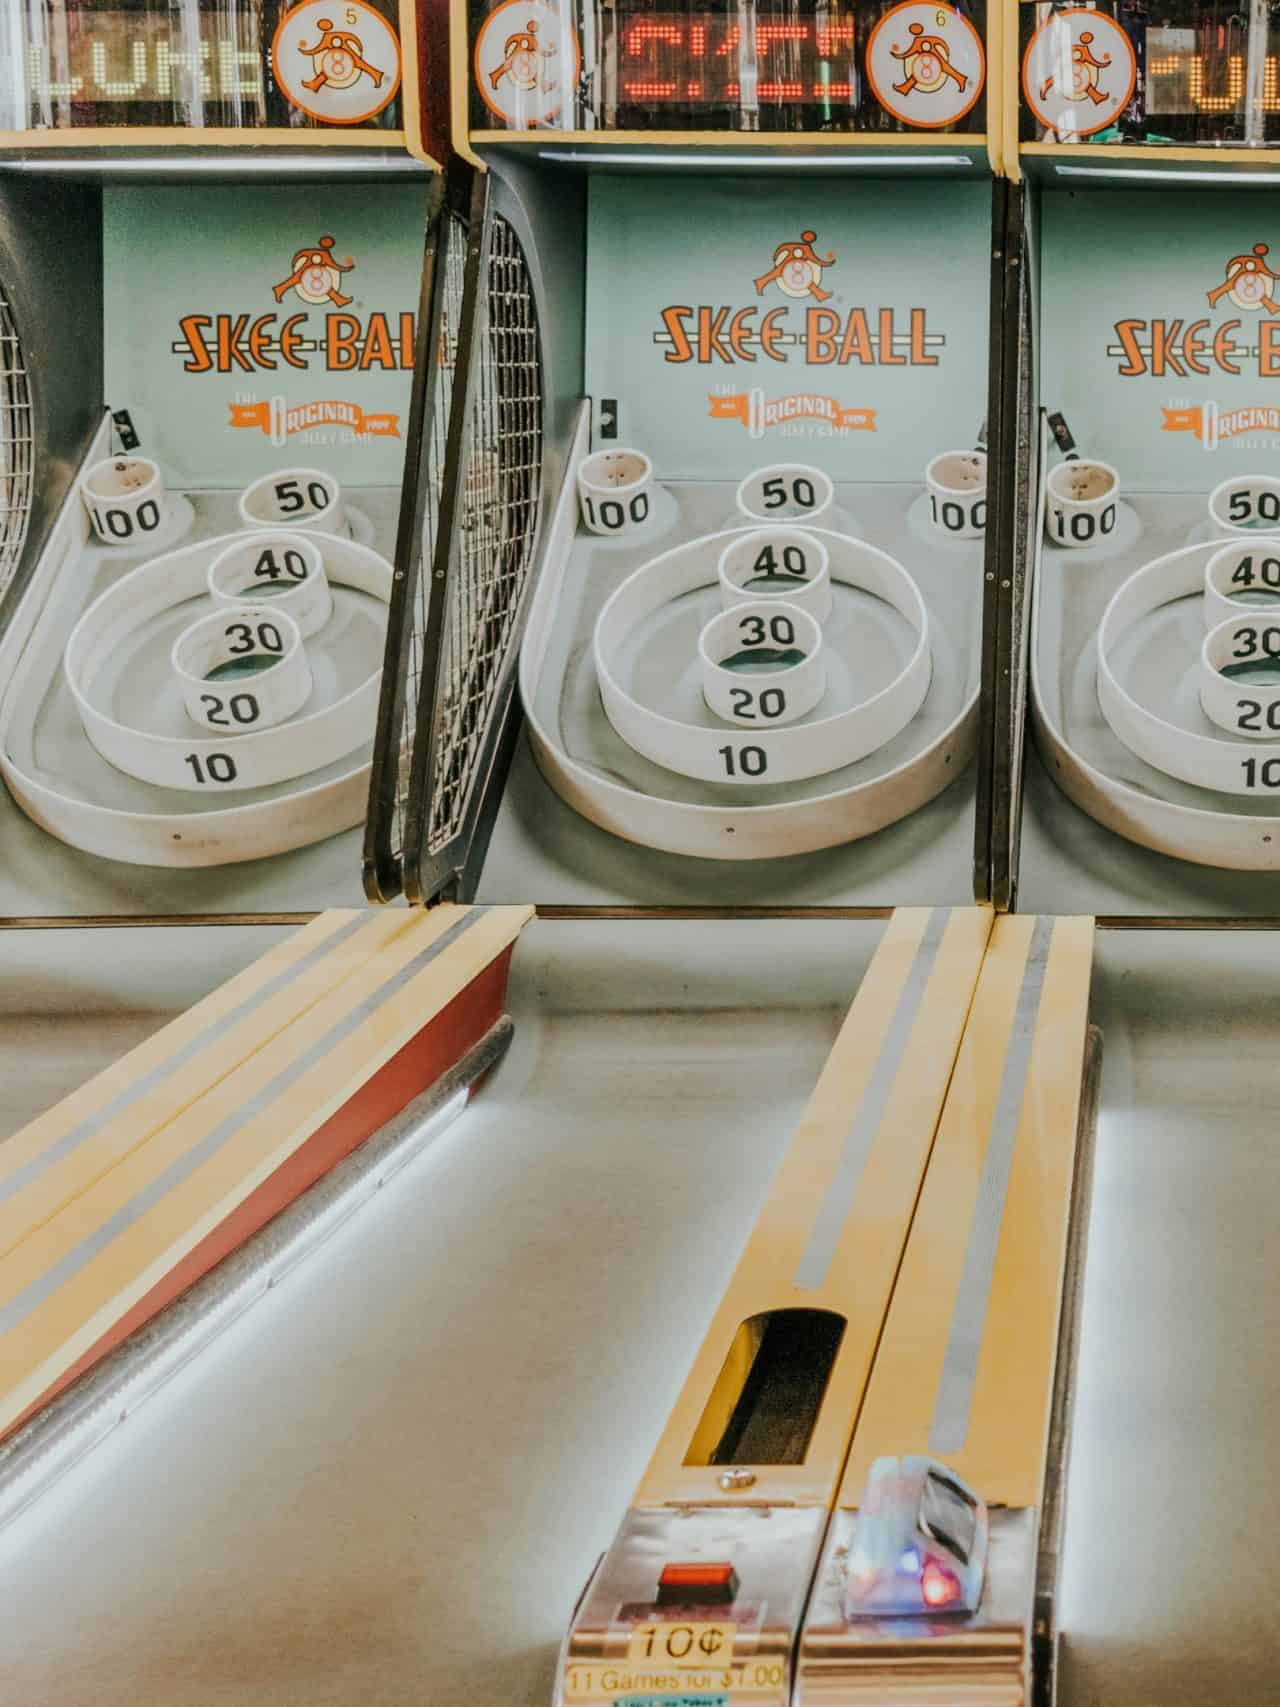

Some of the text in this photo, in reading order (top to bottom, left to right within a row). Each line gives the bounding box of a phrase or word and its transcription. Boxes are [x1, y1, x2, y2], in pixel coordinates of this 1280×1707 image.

[345, 8, 358, 25] 5
[935, 10, 947, 27] 6
[179, 313, 308, 372] SKEE
[660, 305, 939, 366] SKEE BALL
[1114, 319, 1242, 377] SKEE
[270, 394, 360, 447] ORIGINAL
[749, 386, 837, 439] ORIGINAL
[274, 480, 330, 513] 50
[762, 477, 816, 509] 50
[93, 499, 161, 538] 100
[585, 491, 650, 530] 100
[1053, 503, 1117, 542] 100
[254, 549, 308, 580] 40
[753, 544, 808, 577] 40
[224, 622, 284, 654] 30
[738, 615, 796, 647] 30
[200, 693, 261, 726] 20
[729, 687, 787, 720] 20
[183, 752, 238, 784] 10
[718, 745, 769, 777] 10
[639, 1627, 724, 1658] 10¢
[571, 1670, 593, 1690] 11
[601, 1669, 681, 1691] Games
[686, 1671, 713, 1688] for
